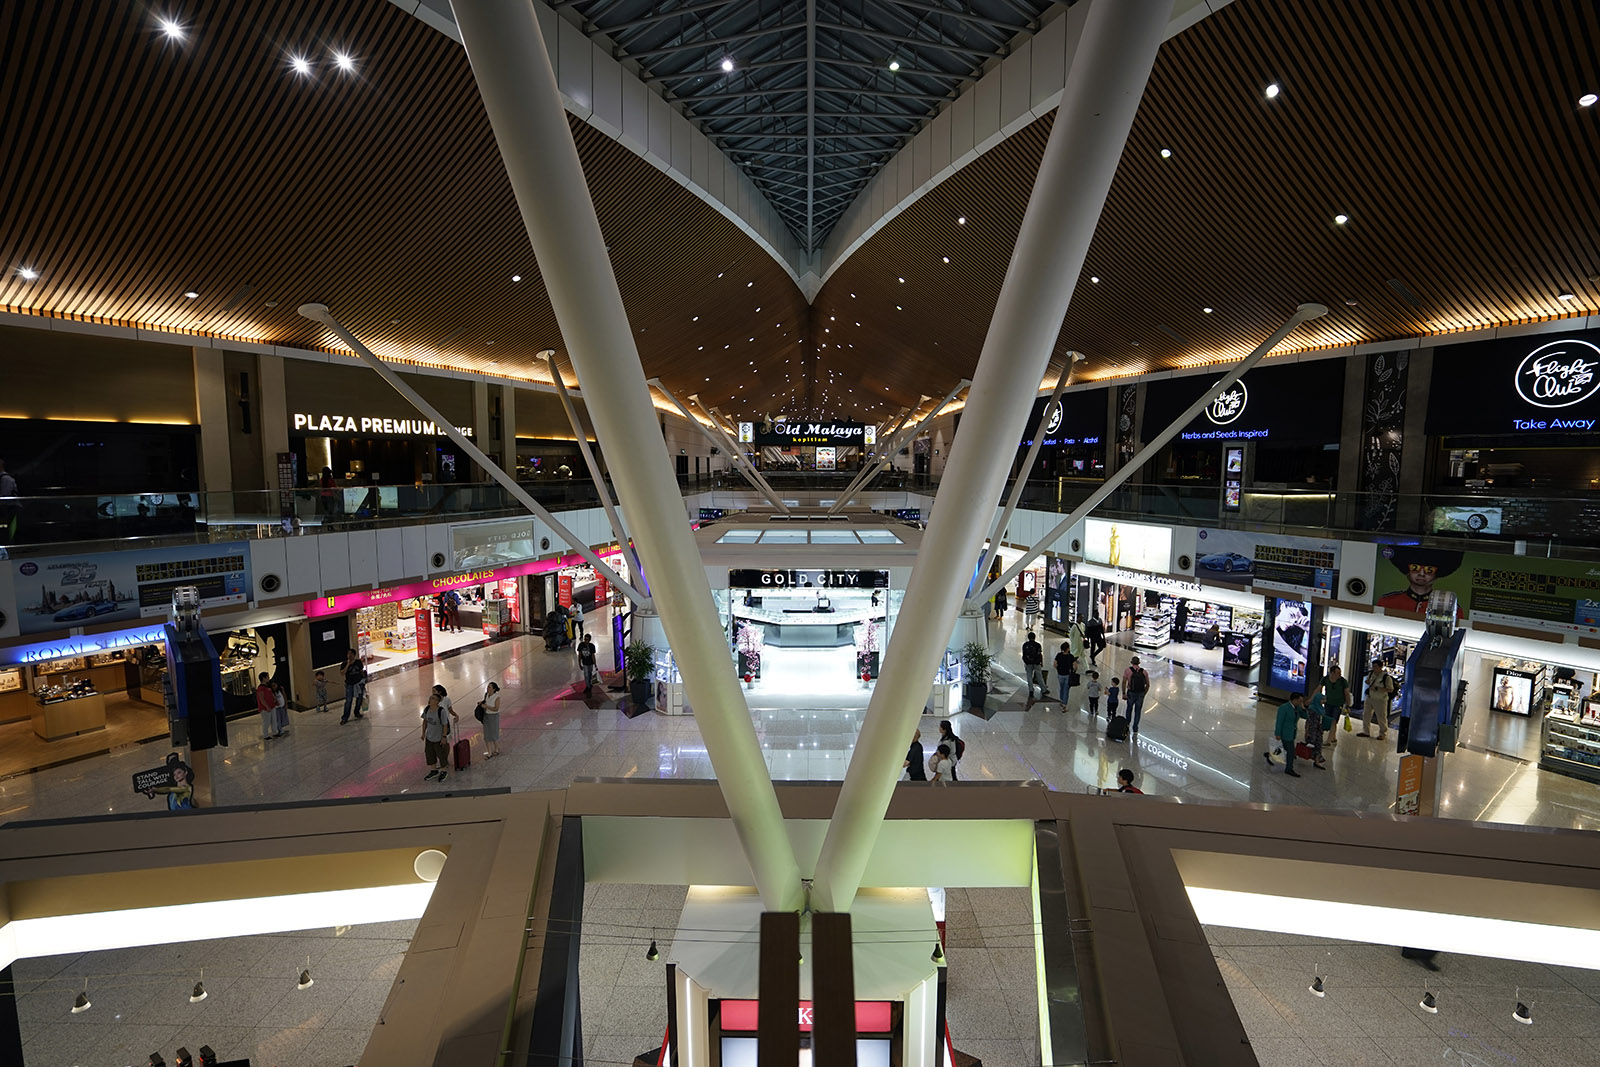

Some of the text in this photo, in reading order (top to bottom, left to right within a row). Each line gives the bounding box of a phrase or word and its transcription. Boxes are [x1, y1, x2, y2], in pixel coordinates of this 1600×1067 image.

[1525, 351, 1599, 379] Flight
[1533, 375, 1582, 398] Club
[294, 413, 473, 437] PLAZA PREMIUM LNGE
[775, 423, 863, 439] Old Malaya
[1513, 418, 1596, 430] Take Away
[1083, 436, 1099, 444] Alcohol
[1181, 428, 1269, 440] Herbs and Seeds Inspired
[61, 564, 98, 586] 25
[1427, 566, 1433, 574] 5
[432, 569, 495, 588] CHOCOLATES
[761, 573, 858, 585] GOLD CITY
[1116, 569, 1151, 583] PERFUMES
[1158, 577, 1202, 592] COSMETICS
[1472, 577, 1546, 593] ESCAPADE
[1473, 567, 1600, 590] A ROYAL LONDO
[1584, 598, 1599, 608] 2x
[25, 630, 166, 663] ROYAL SELANGO
[1506, 670, 1522, 678] Dior
[136, 771, 158, 780] STAND
[138, 772, 170, 785] TALL WITH
[138, 778, 167, 790] COURAGE
